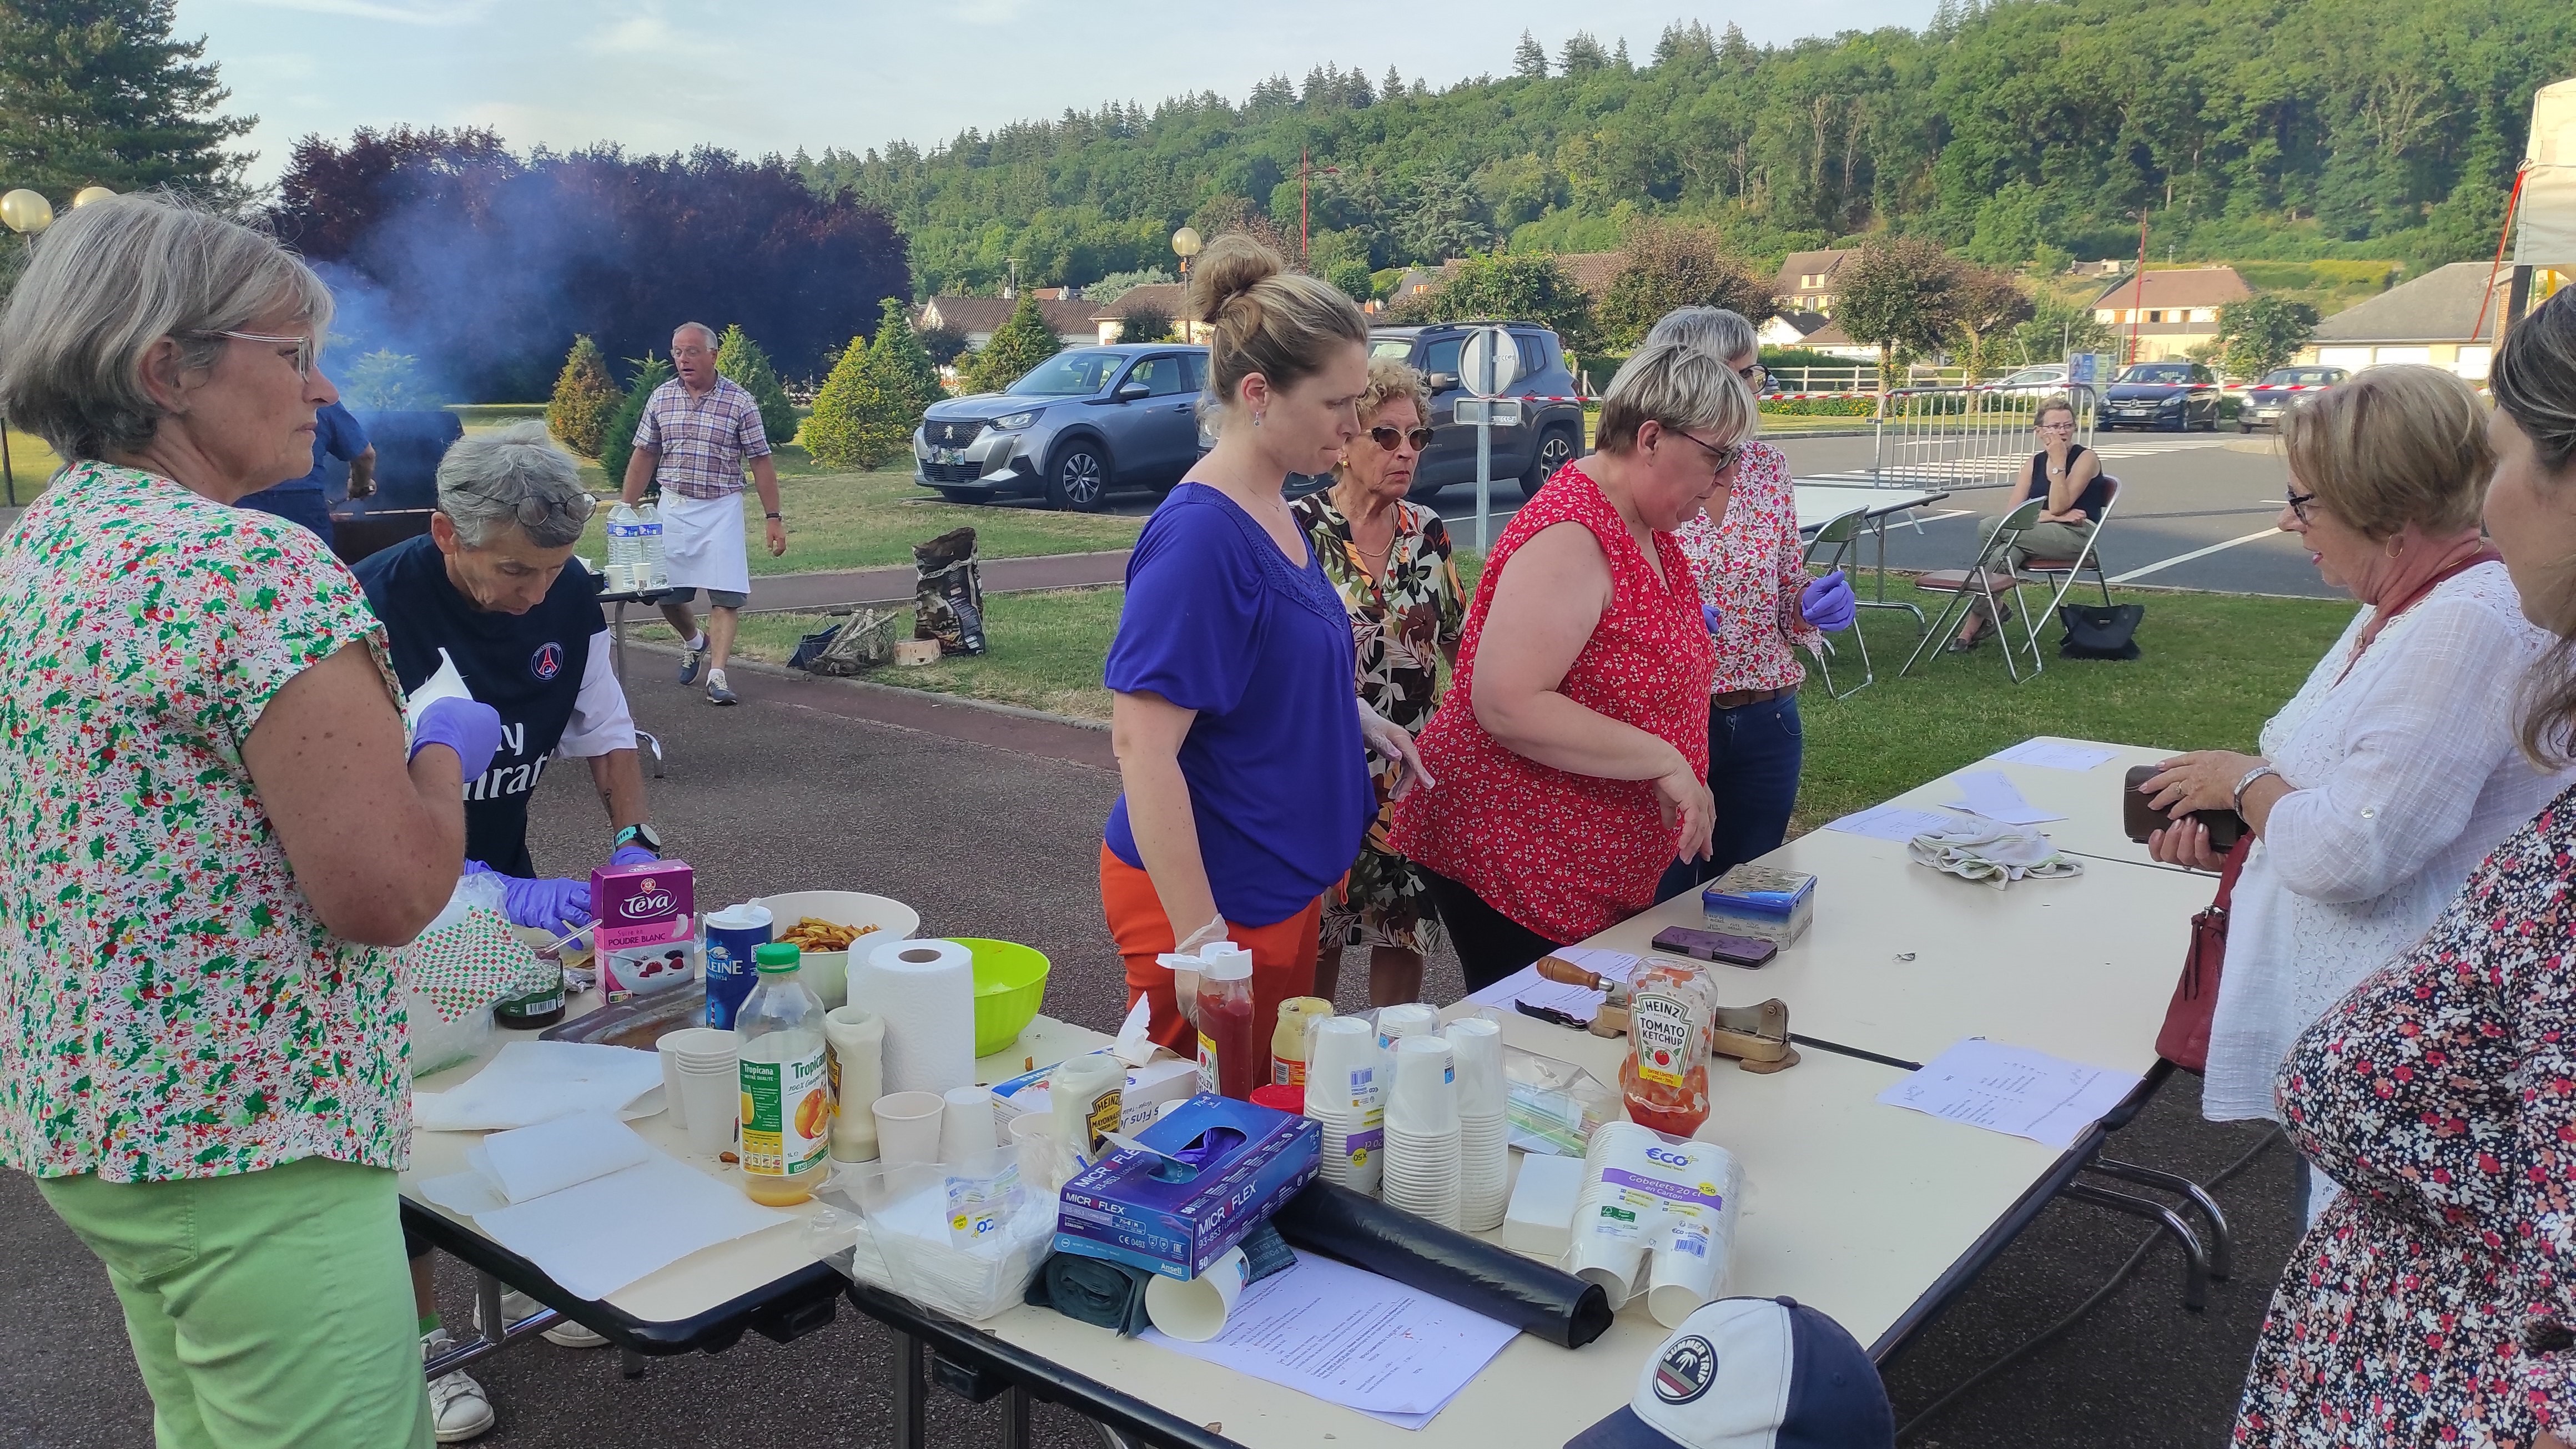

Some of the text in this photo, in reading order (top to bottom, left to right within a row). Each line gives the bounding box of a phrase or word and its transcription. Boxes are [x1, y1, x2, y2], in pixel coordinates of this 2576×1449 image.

[624, 893, 670, 914] Téva
[608, 933, 666, 947] POUDRE BLANC
[706, 959, 743, 975] LEINE
[1645, 1001, 1680, 1018] HEINZ
[1639, 1017, 1685, 1038] TOMATO
[1642, 1030, 1683, 1046] KETCHUP
[743, 1063, 774, 1075] Tropicana
[1097, 1094, 1121, 1113] HEINZ
[1130, 1109, 1153, 1125] Fins
[1353, 1152, 1367, 1161] x50
[794, 1163, 807, 1172] SANS
[1073, 1148, 1142, 1188] MICROFLE
[1628, 1174, 1675, 1192] Gobelets
[1676, 1186, 1690, 1195] 20
[1699, 1185, 1716, 1194] x50
[1657, 1188, 1683, 1200] Carton
[1198, 1226, 1222, 1249] 93-853
[1198, 1257, 1209, 1271] 50
[1664, 1339, 1710, 1384] SUMMER TRIP
